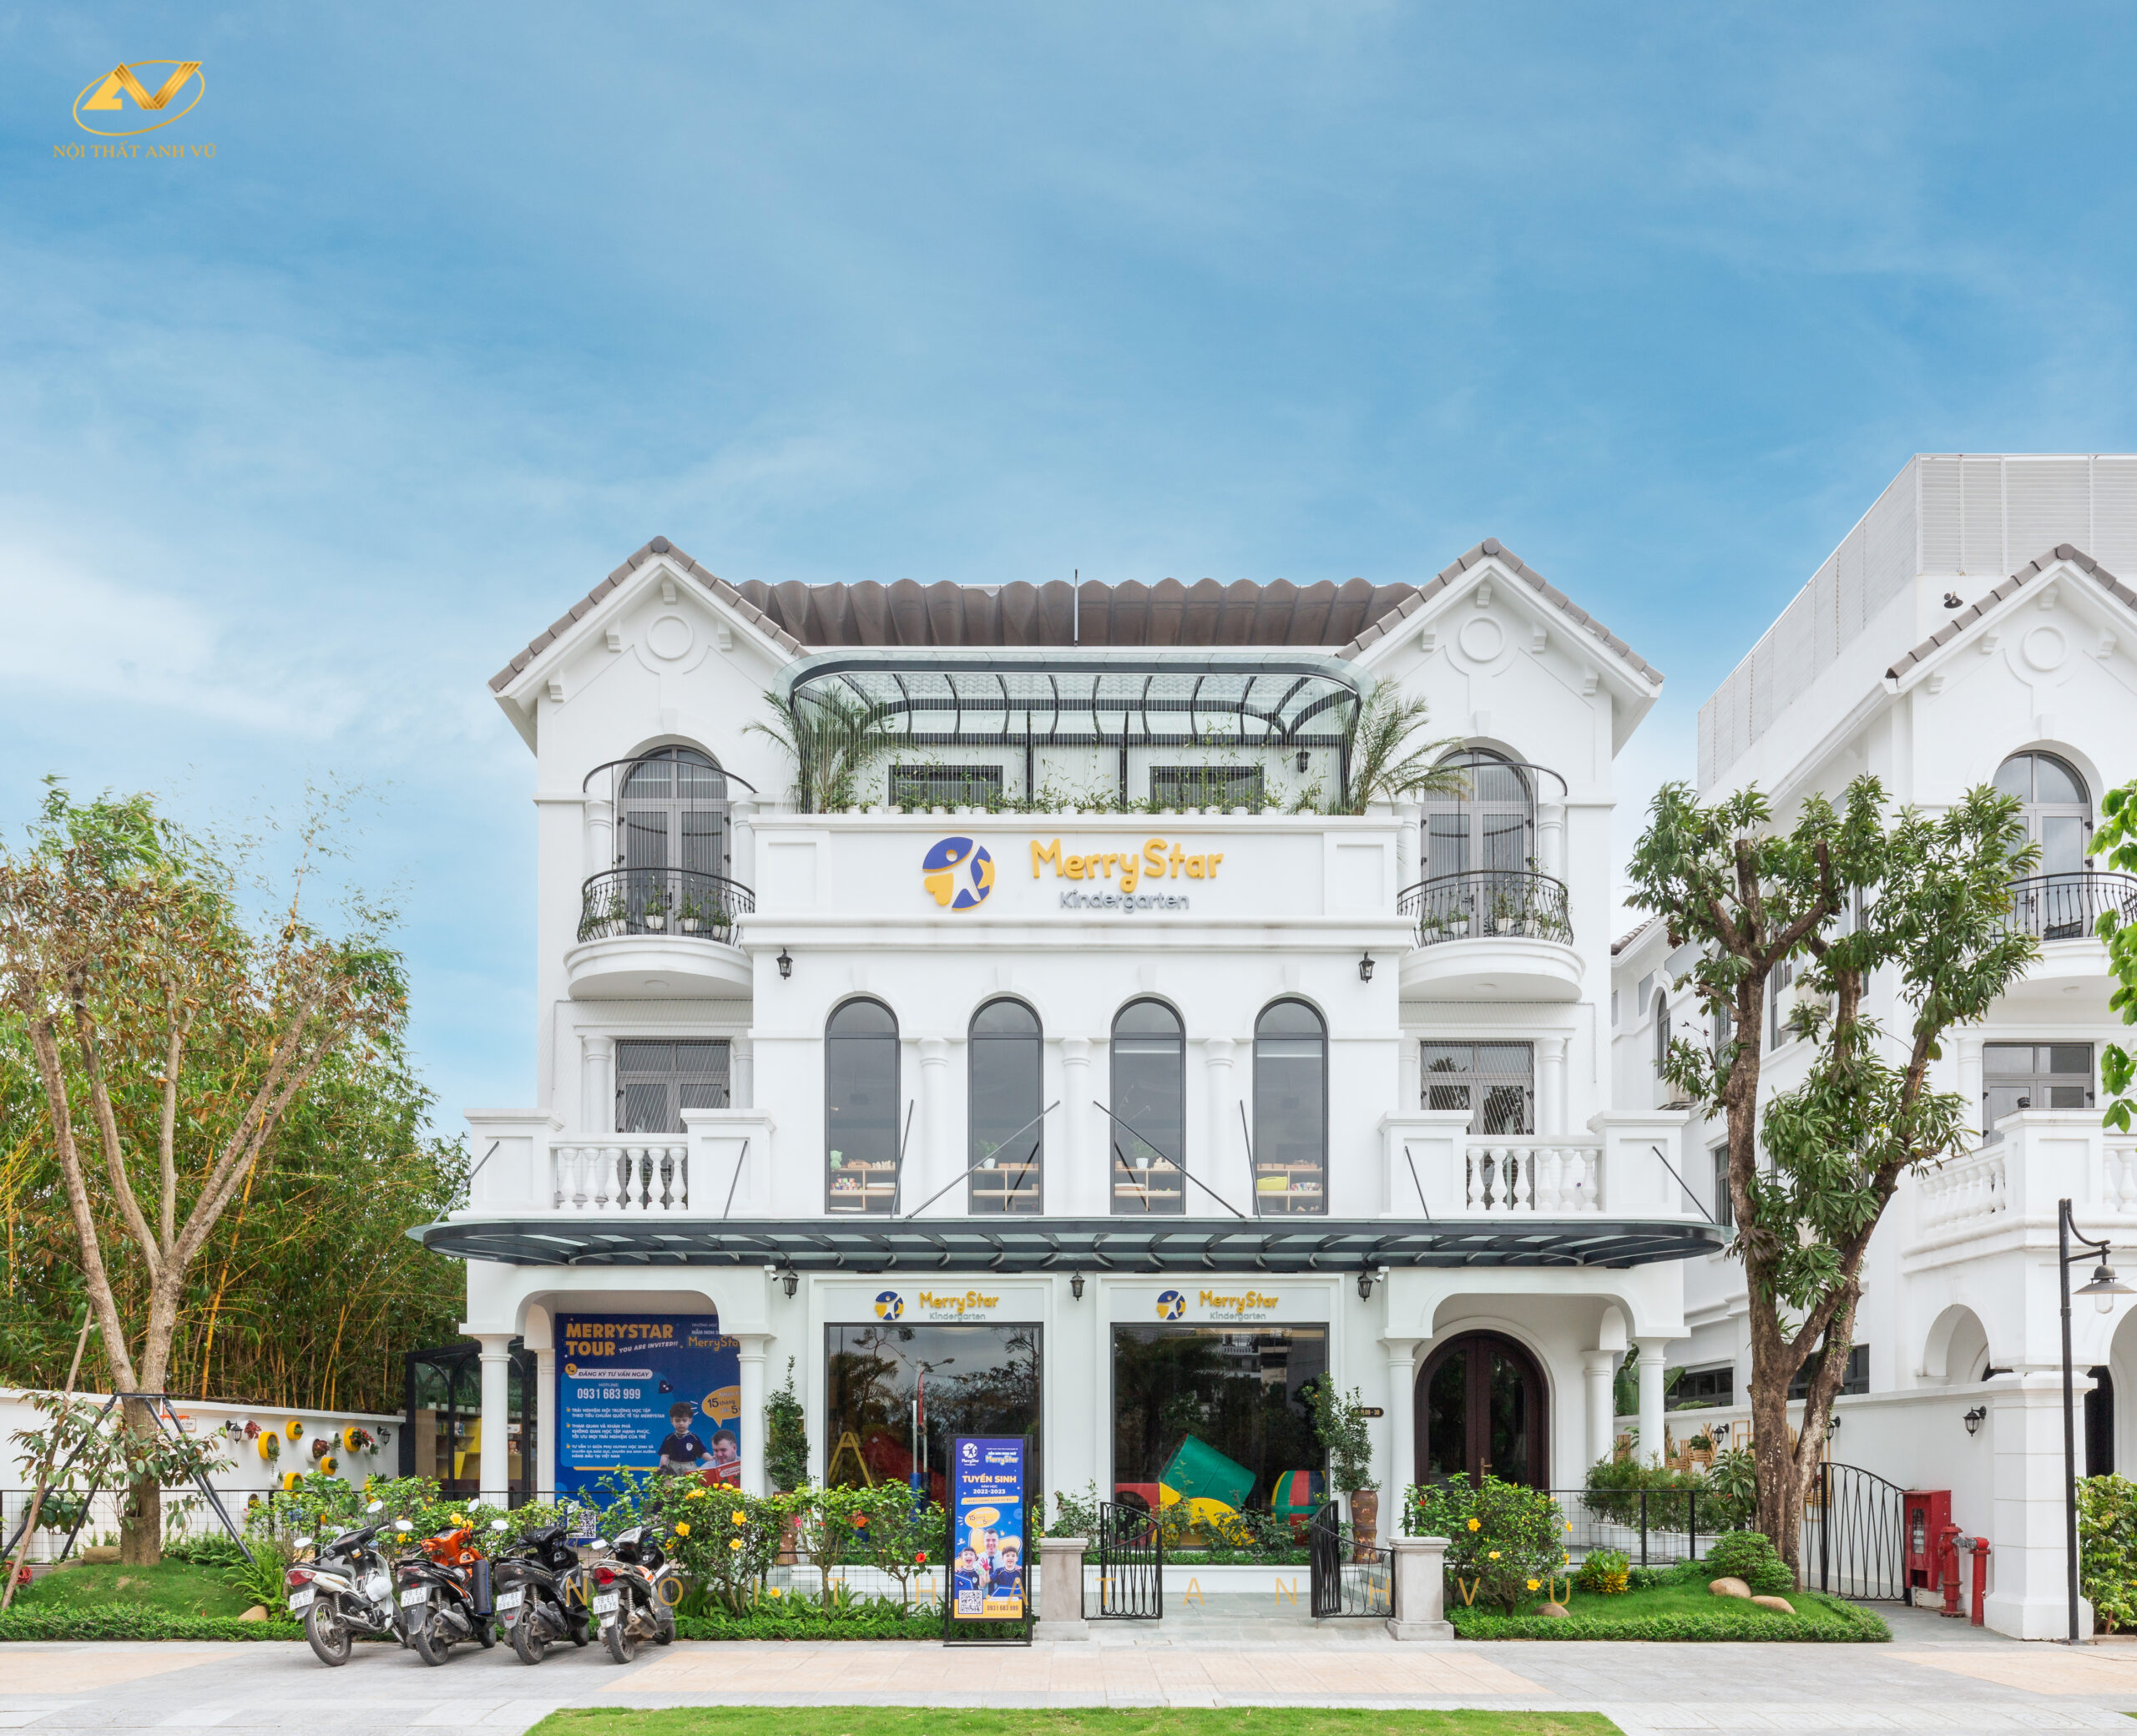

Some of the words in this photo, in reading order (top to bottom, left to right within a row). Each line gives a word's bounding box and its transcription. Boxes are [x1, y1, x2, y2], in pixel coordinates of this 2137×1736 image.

[1059, 889, 1190, 913] Kindergarten
[929, 1311, 986, 1322] Kindergarten
[1210, 1311, 1266, 1322] Kindergarten
[566, 1323, 674, 1339] MERRYSTAR
[565, 1340, 616, 1356] TOUR
[619, 1345, 632, 1354] YOU
[688, 1336, 740, 1351] MerrySta
[577, 1388, 600, 1400] 0931
[603, 1388, 621, 1400] 683
[623, 1388, 641, 1400] 999
[707, 1397, 720, 1409] 15
[731, 1405, 738, 1414] 5
